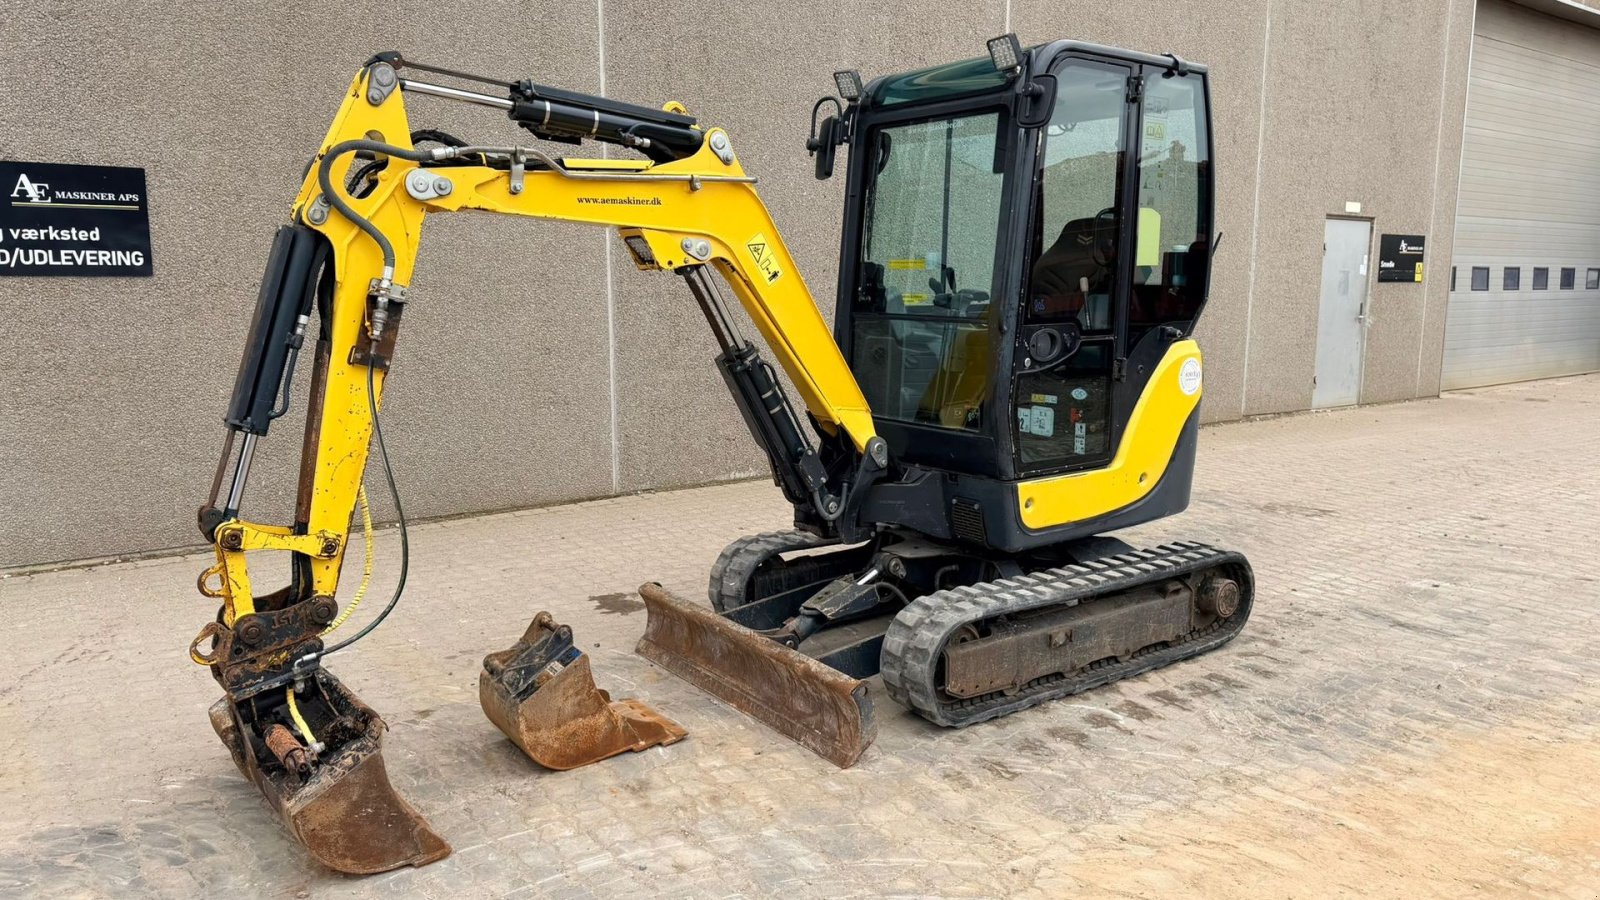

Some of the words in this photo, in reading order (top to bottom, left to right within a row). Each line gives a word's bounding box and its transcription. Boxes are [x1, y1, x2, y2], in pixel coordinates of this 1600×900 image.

[55, 191, 116, 201] MASKINER
[577, 197, 662, 205] www.aemaskiner.dk
[9, 225, 100, 241] værksted
[0, 248, 144, 267] D/UDLEVERING
